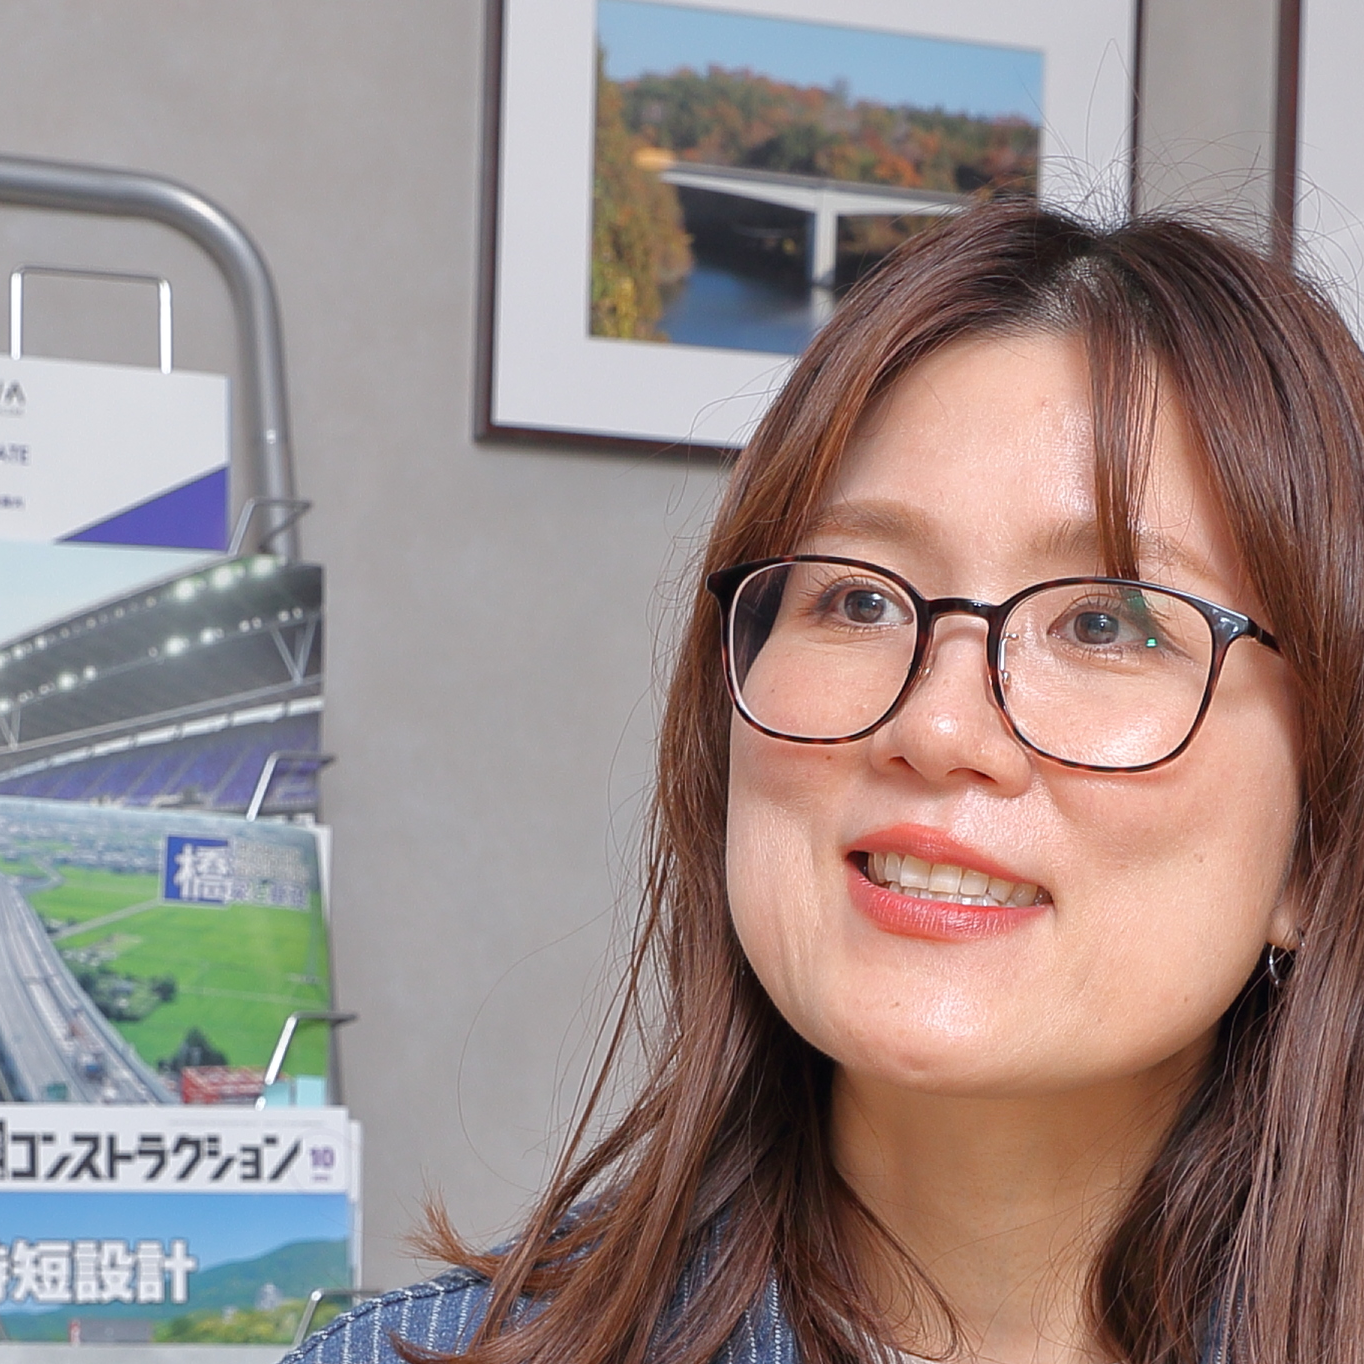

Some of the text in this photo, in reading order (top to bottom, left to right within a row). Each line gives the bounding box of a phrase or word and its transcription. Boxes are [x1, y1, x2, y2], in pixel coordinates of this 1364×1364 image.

[11, 1133, 303, 1180] コンストラクション
